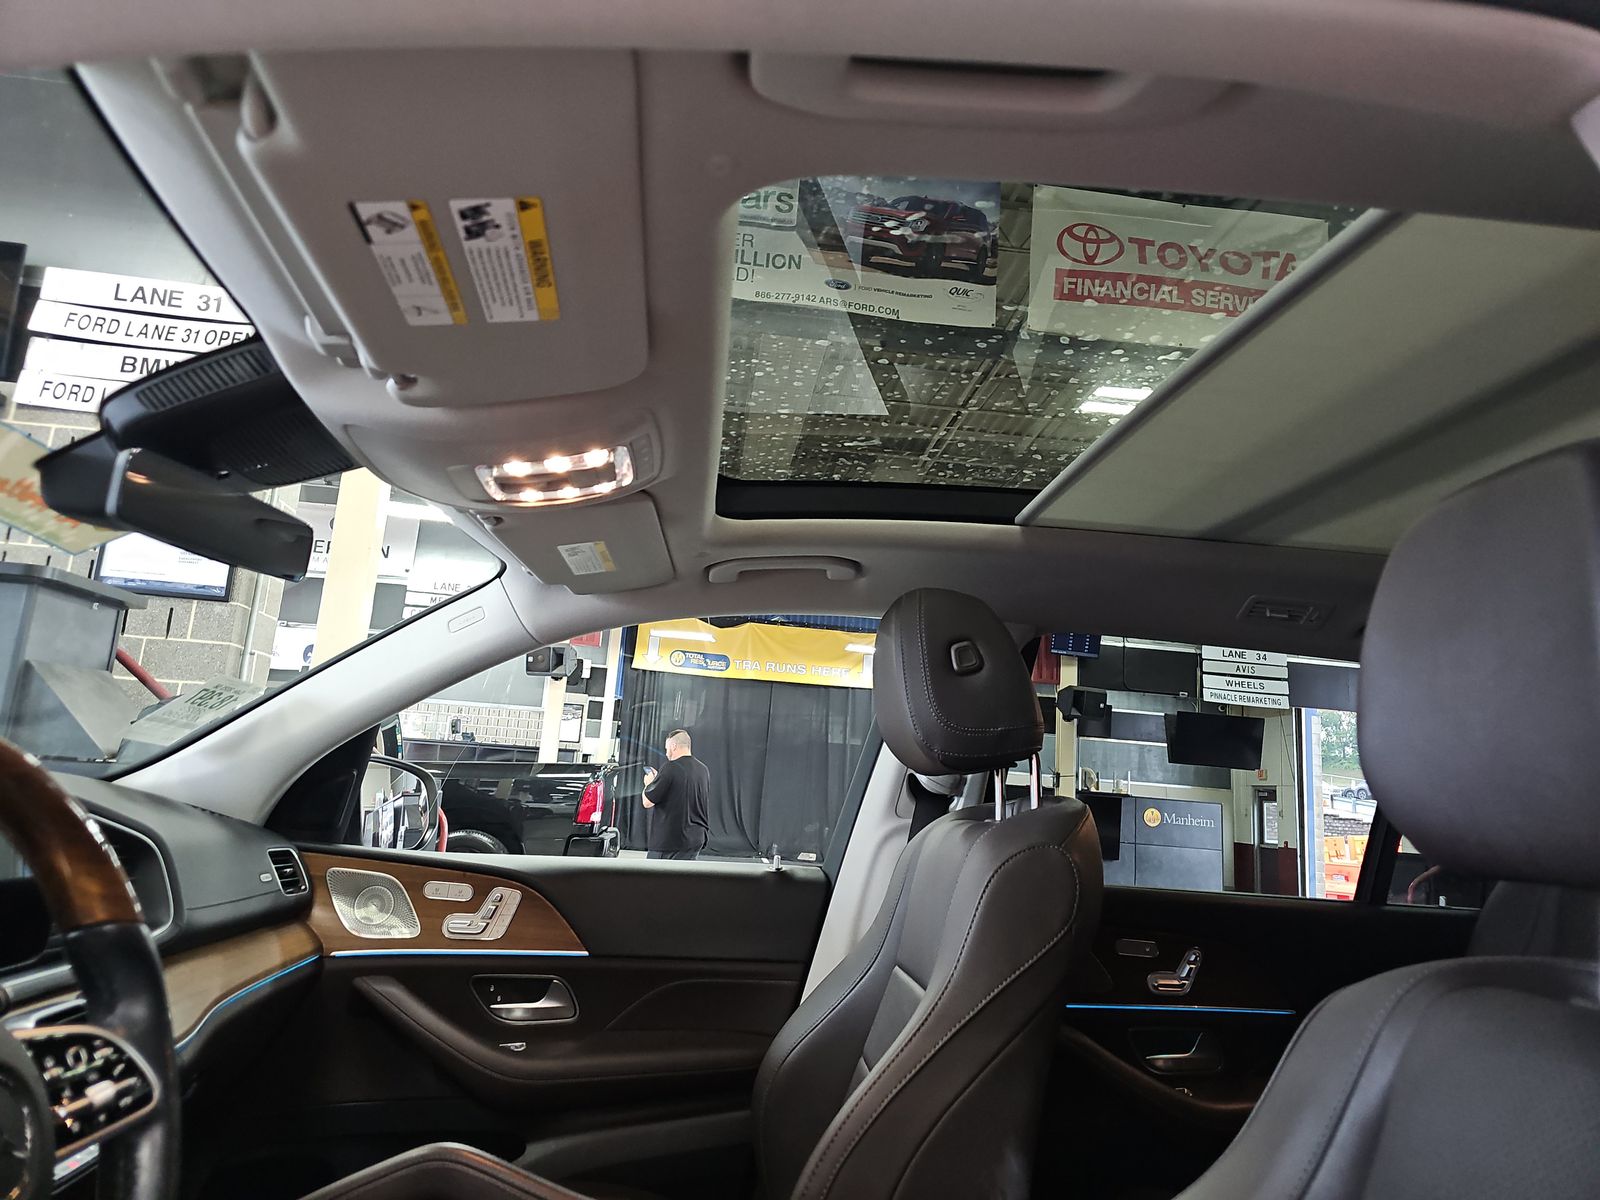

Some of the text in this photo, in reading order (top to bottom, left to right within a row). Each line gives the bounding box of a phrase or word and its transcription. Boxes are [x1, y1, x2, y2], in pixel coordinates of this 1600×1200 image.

[1128, 237, 1297, 281] TOYOTA
[114, 283, 222, 313] LANE 31
[1062, 277, 1185, 304] FINANCIAL
[818, 297, 900, 316] ARS@FORD.COM
[64, 312, 121, 336] FORD
[124, 320, 178, 342] LANE
[181, 328, 201, 344] 31
[39, 380, 95, 404] FORD
[433, 582, 461, 592] LANE
[1222, 649, 1268, 662] LANE 34
[733, 659, 761, 671] TRA
[765, 662, 807, 675] RUNS
[811, 665, 850, 677] HERE
[1235, 664, 1256, 674] AVIS
[1225, 679, 1265, 690] WHEELS
[1209, 691, 1282, 706] PINNACLE REMARKETING
[1163, 812, 1215, 828] Manheim
